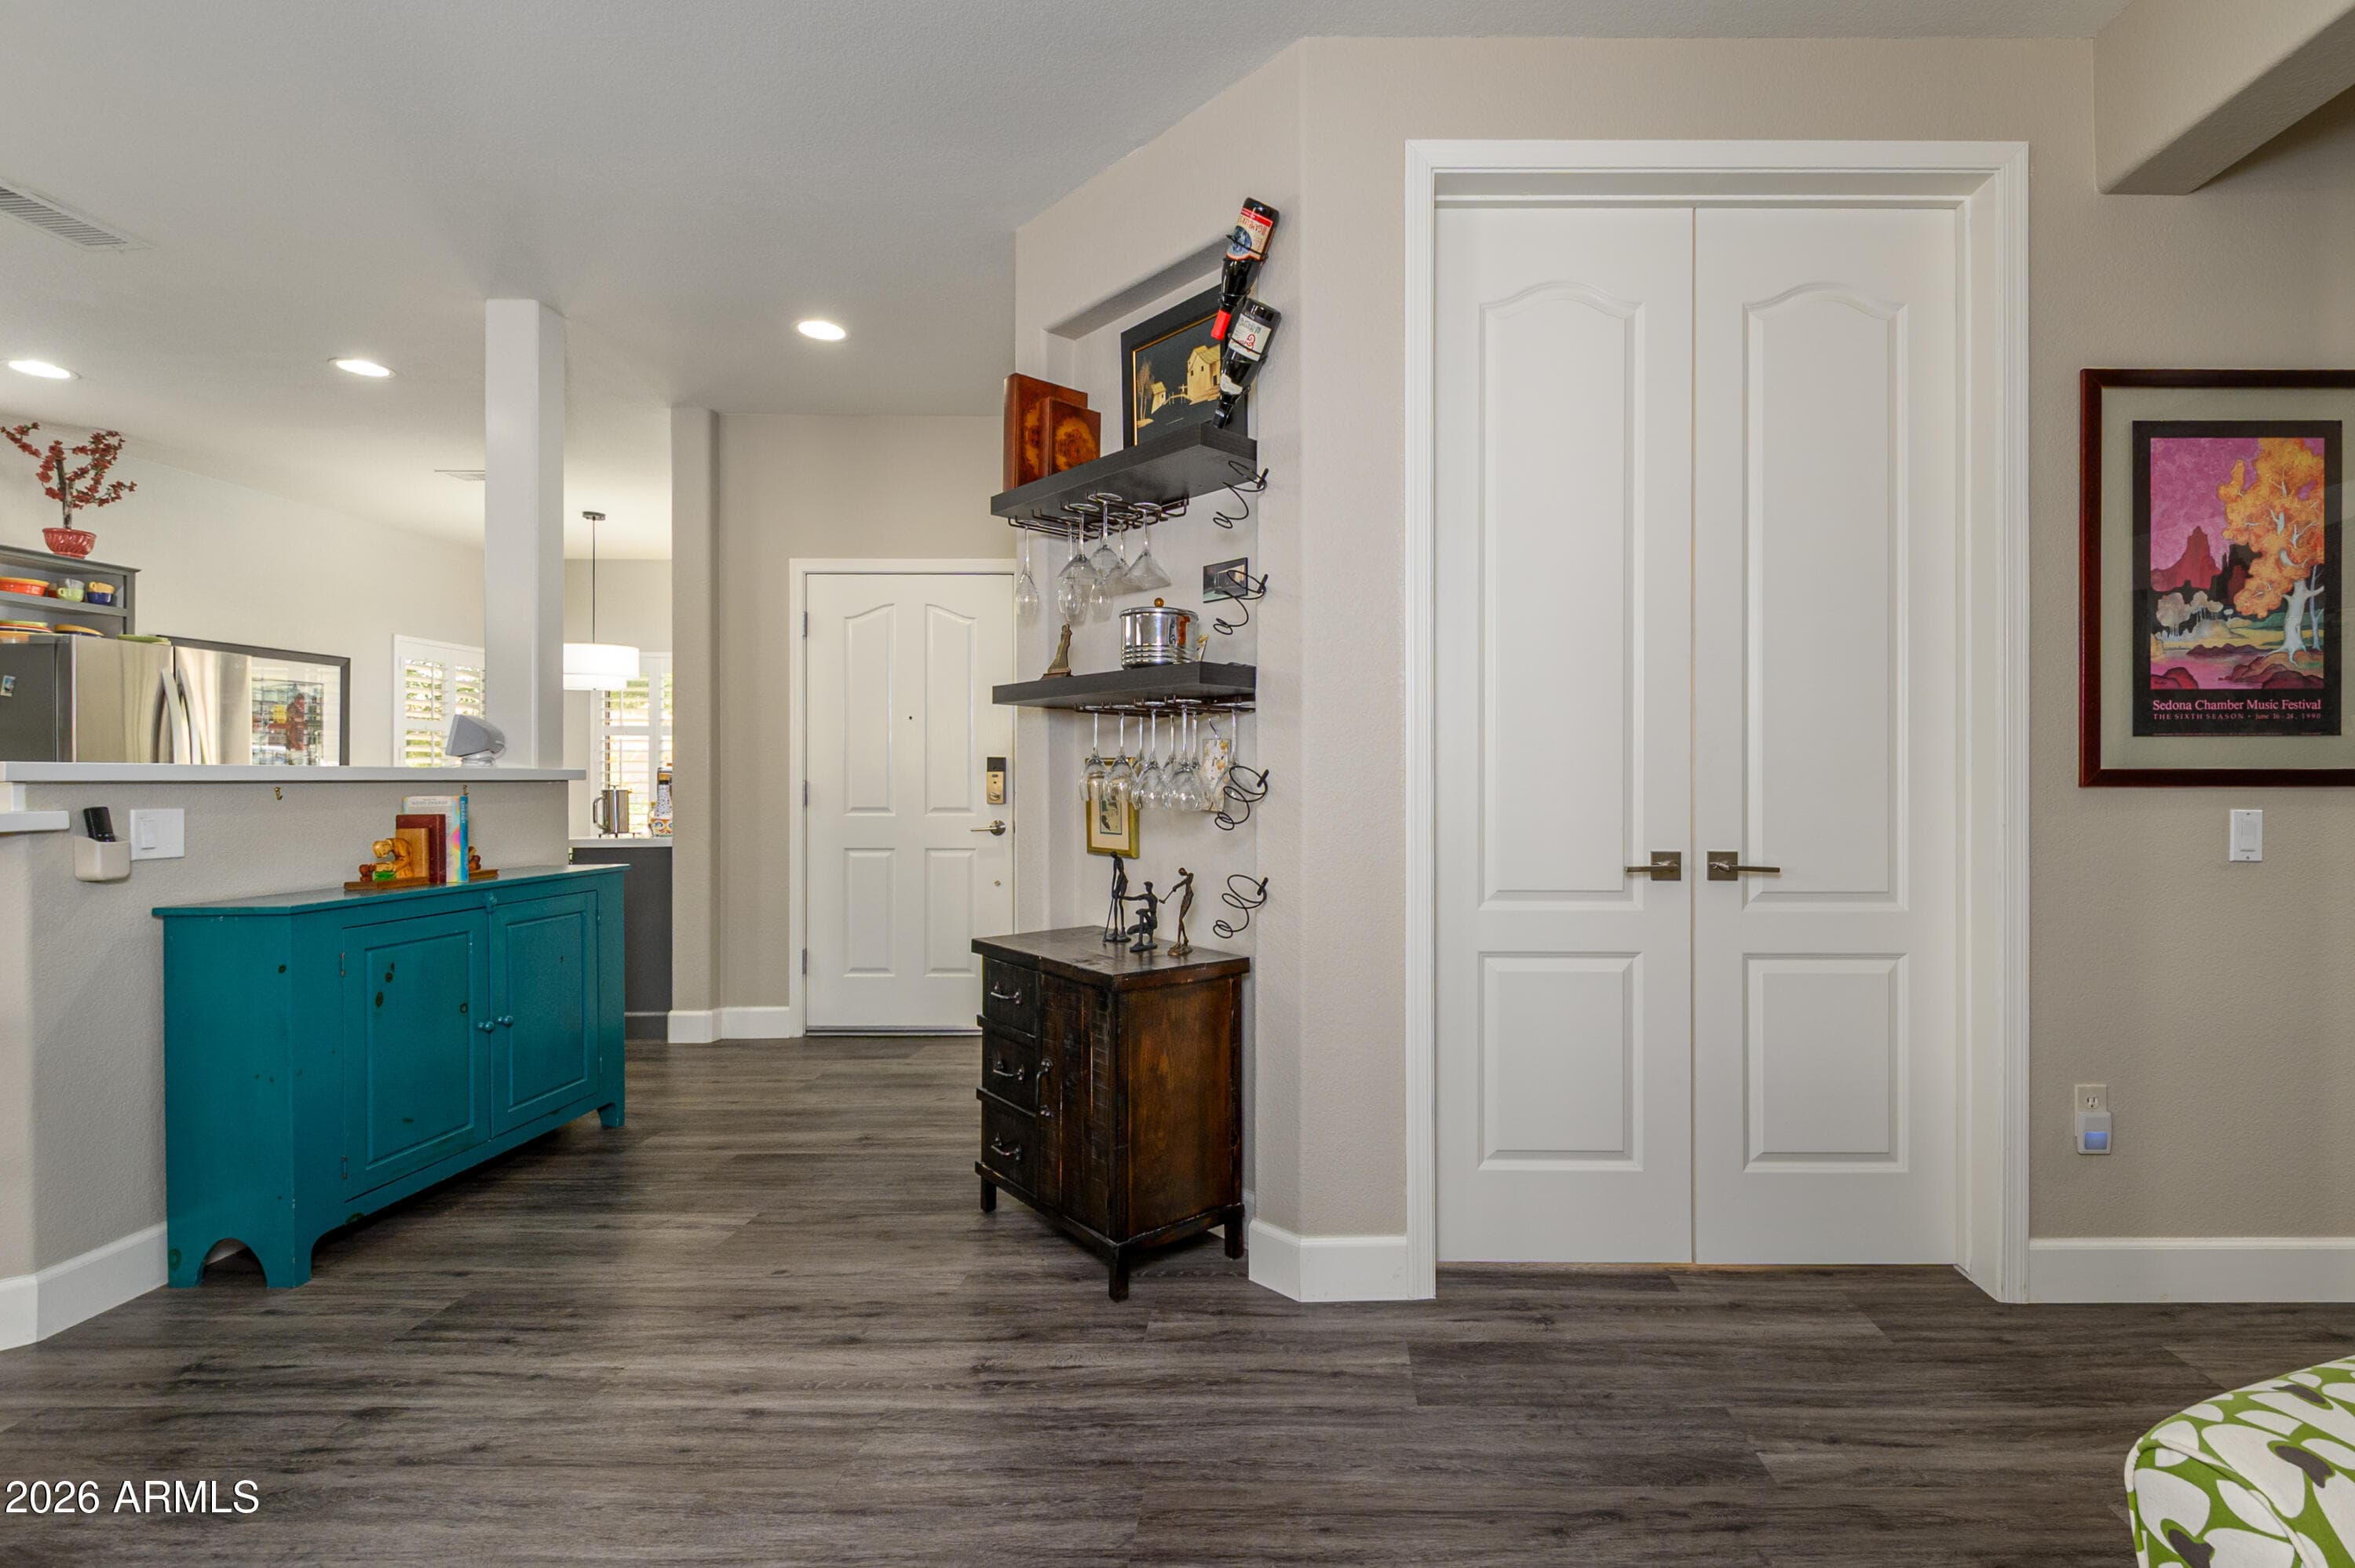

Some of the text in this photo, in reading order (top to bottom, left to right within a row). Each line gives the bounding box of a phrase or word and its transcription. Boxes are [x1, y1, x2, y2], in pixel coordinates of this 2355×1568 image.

[2152, 699, 2321, 710] Sedona Chamber Music Festival
